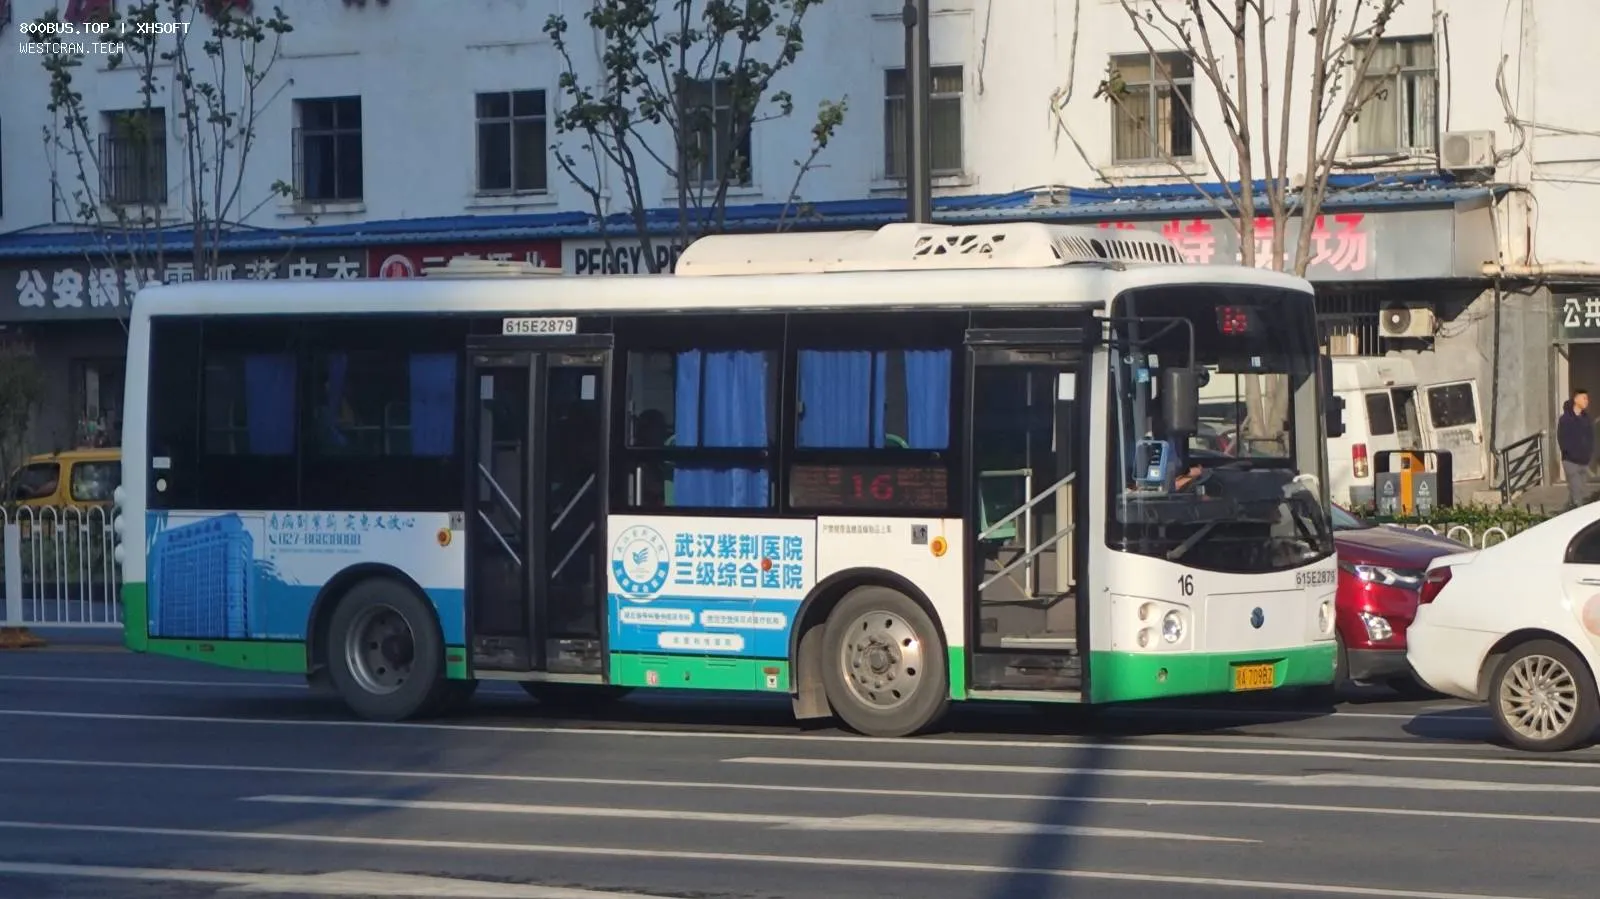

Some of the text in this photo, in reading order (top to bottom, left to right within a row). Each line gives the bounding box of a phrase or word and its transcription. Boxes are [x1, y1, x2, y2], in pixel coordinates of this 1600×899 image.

[1563, 297, 1600, 328] 公共
[505, 319, 574, 334] 615E2879
[852, 474, 894, 500] 16
[674, 532, 803, 561] 武汉紫荆医院
[674, 561, 803, 589] 三级综合医院
[1177, 574, 1194, 596] 16
[1296, 570, 1336, 585] 615E2879
